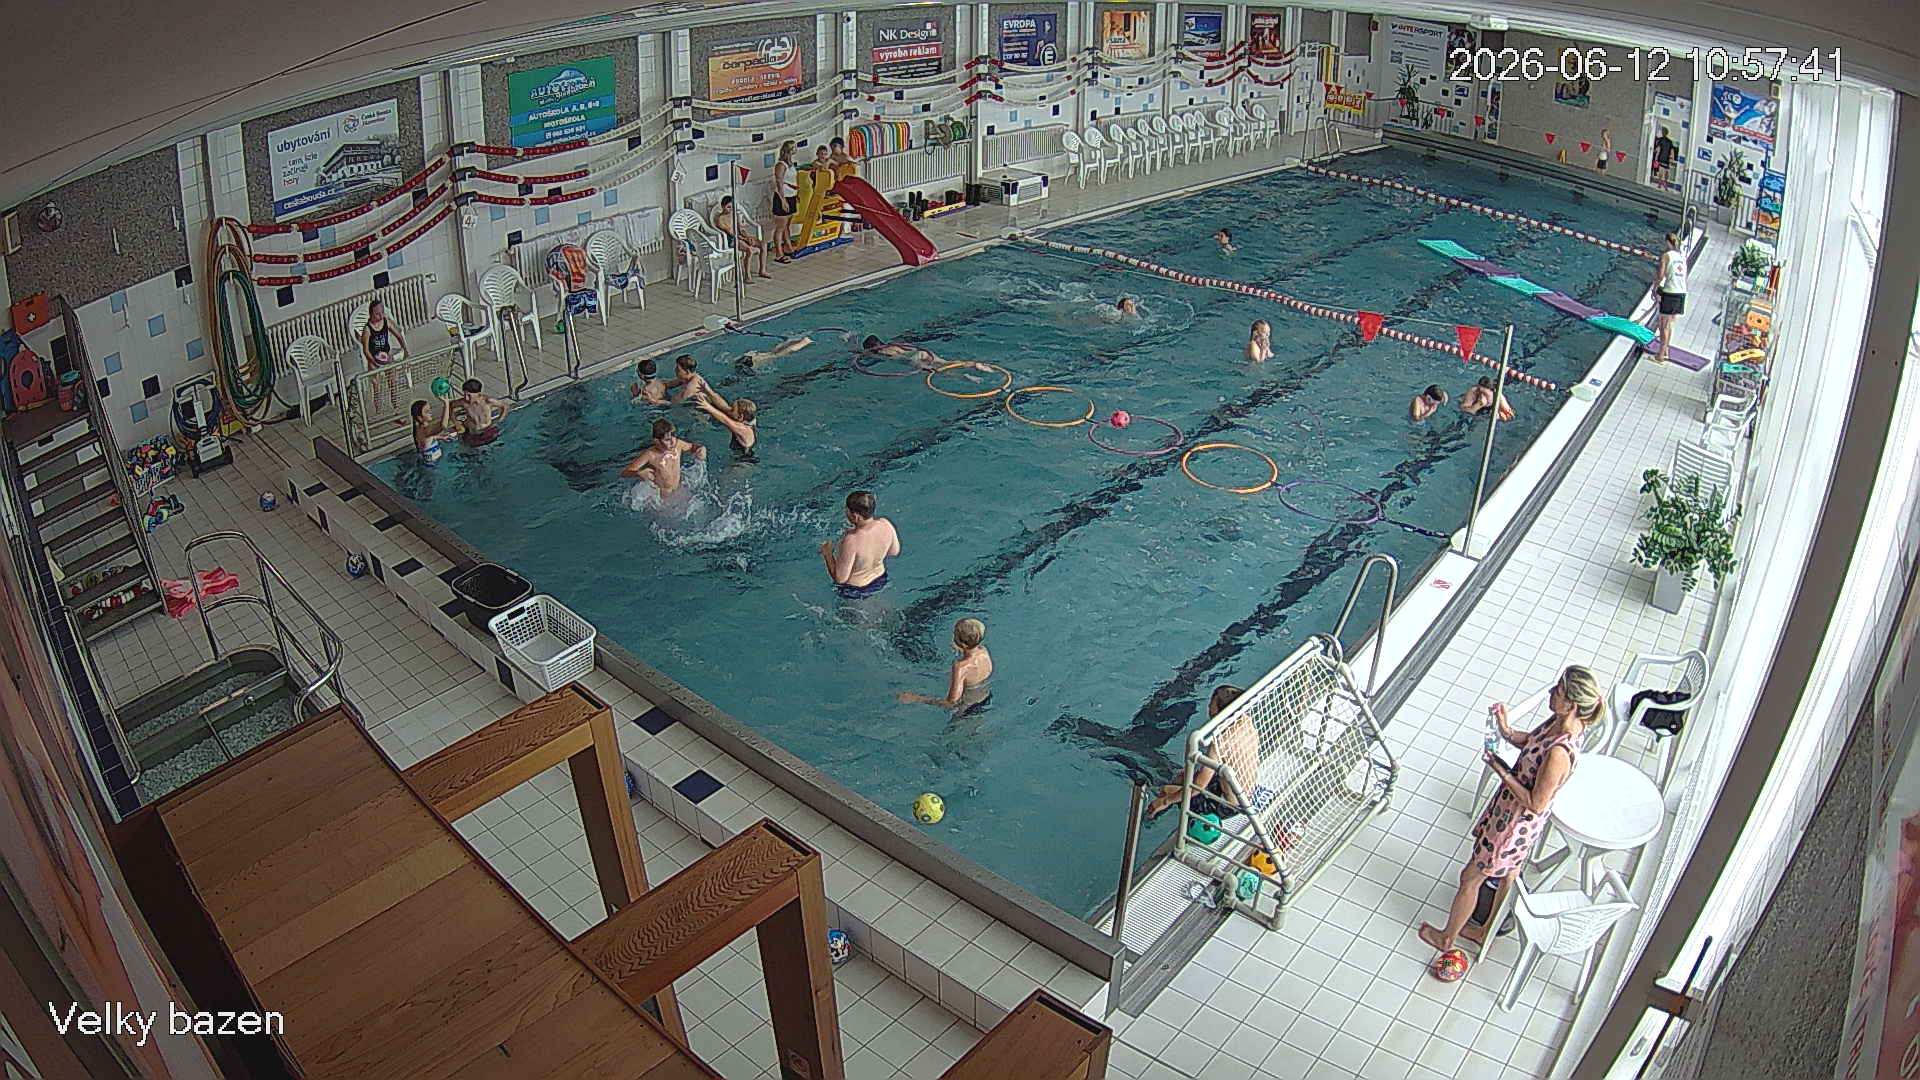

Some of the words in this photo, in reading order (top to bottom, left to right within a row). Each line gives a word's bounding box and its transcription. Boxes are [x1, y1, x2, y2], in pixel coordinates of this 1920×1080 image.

[1003, 19, 1036, 29] EVROPA
[880, 29, 898, 42] NK
[880, 48, 908, 61] výroba
[909, 46, 937, 56] reklam
[276, 127, 332, 153] ubytování
